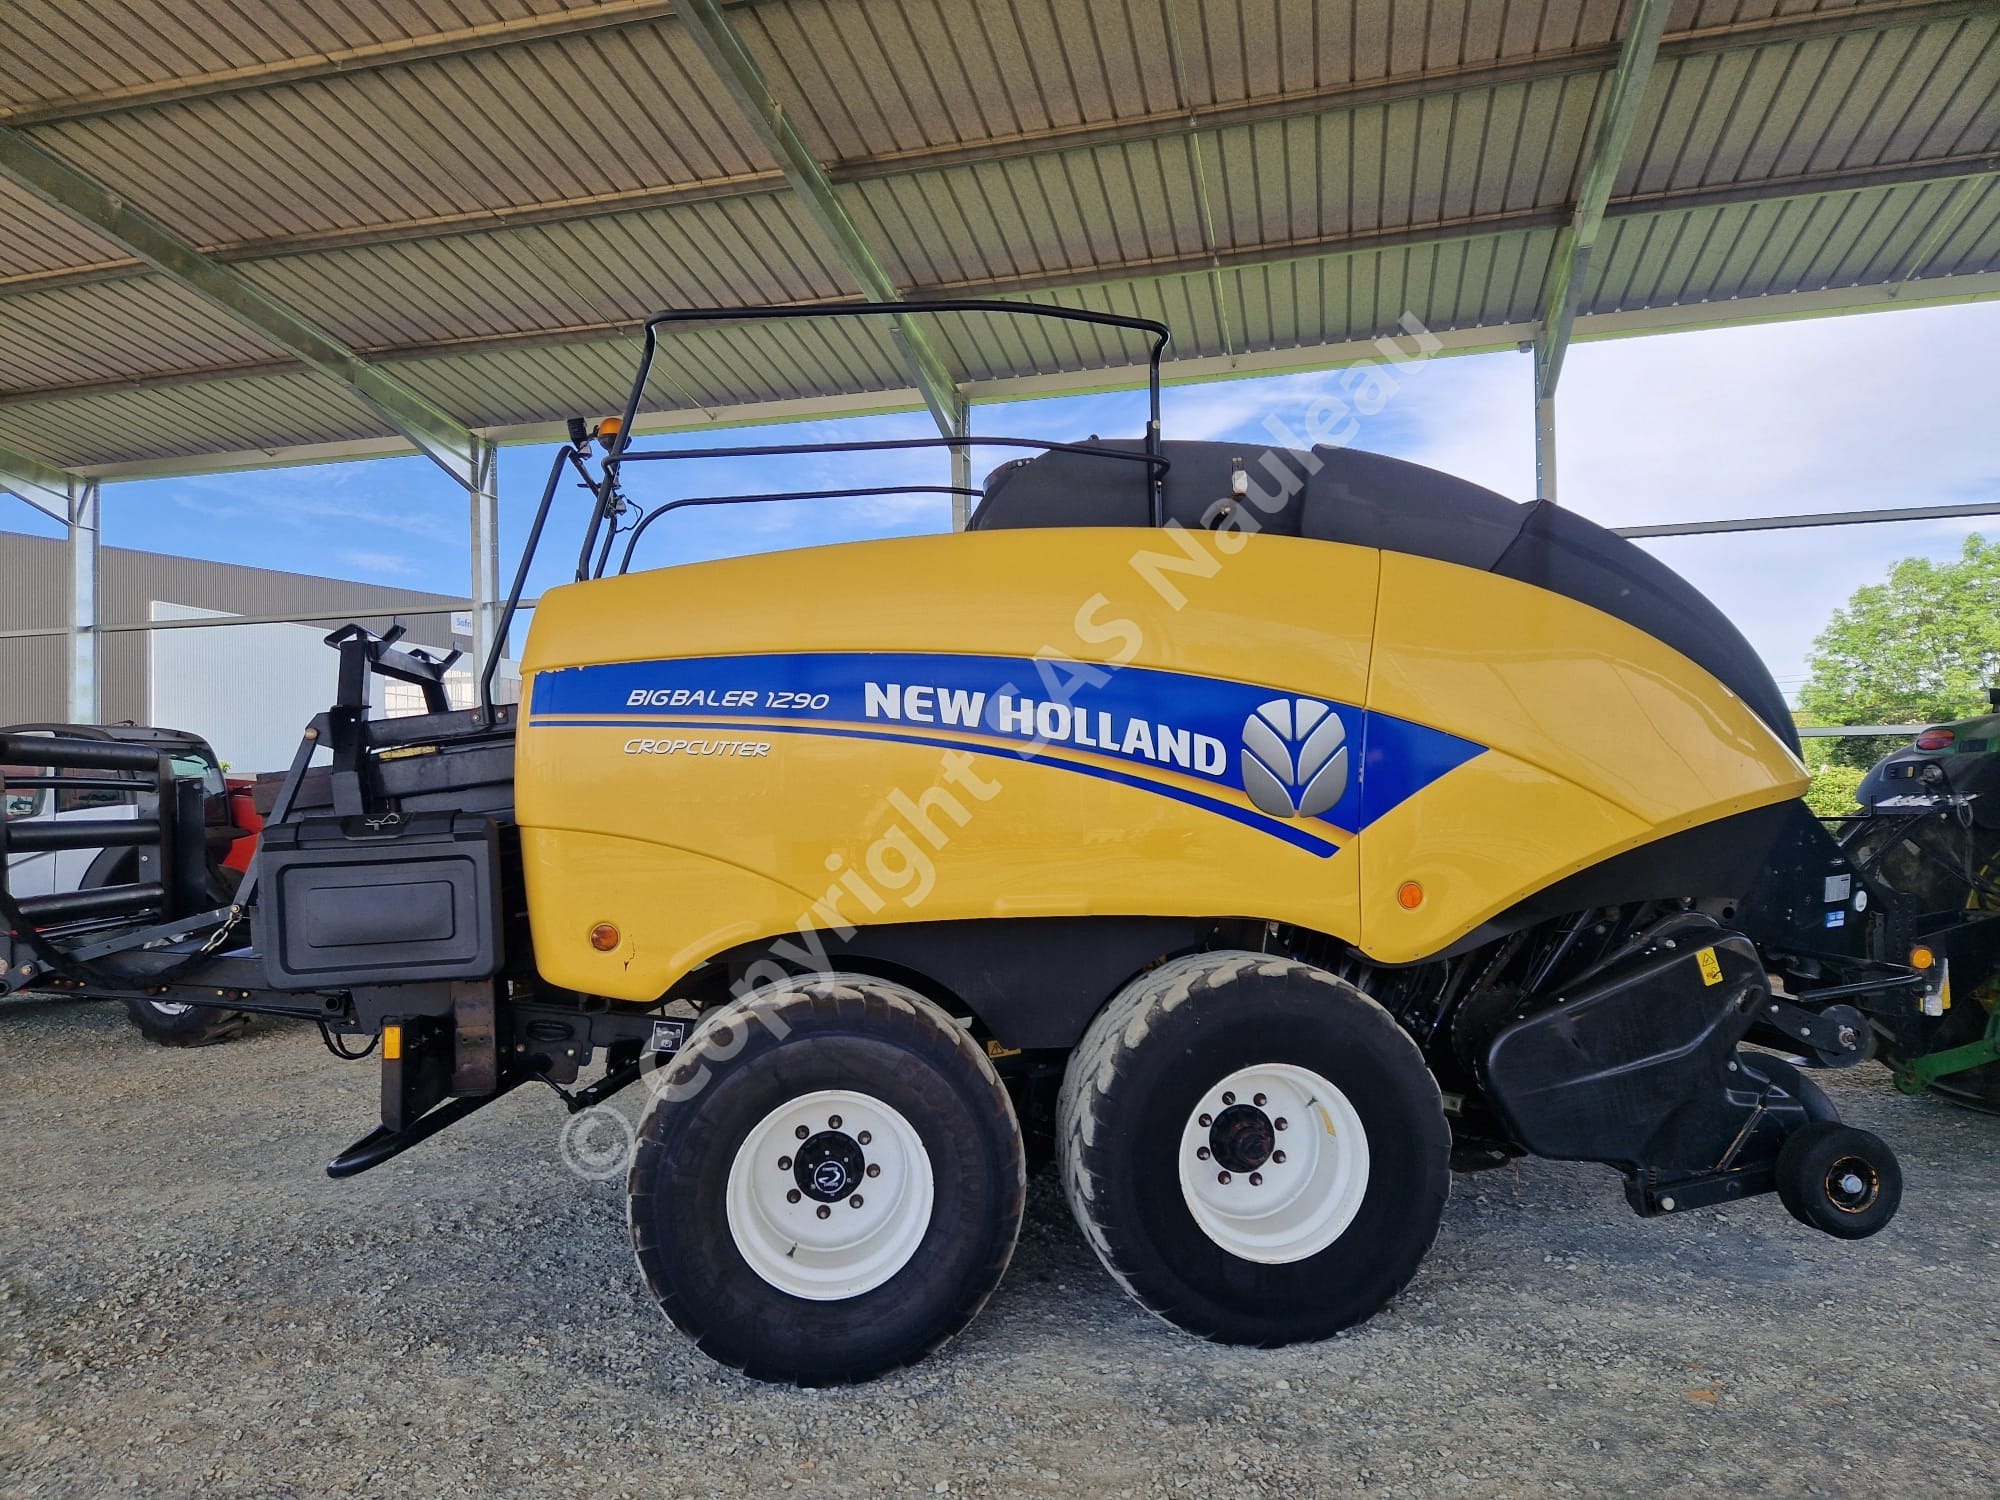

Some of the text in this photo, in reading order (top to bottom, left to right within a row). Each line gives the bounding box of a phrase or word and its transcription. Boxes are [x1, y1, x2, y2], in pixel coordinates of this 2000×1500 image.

[626, 689, 830, 710] BIGBALER 1290
[864, 682, 1227, 776] NEW HOLLAND
[624, 738, 771, 758] CROPCUTTER
